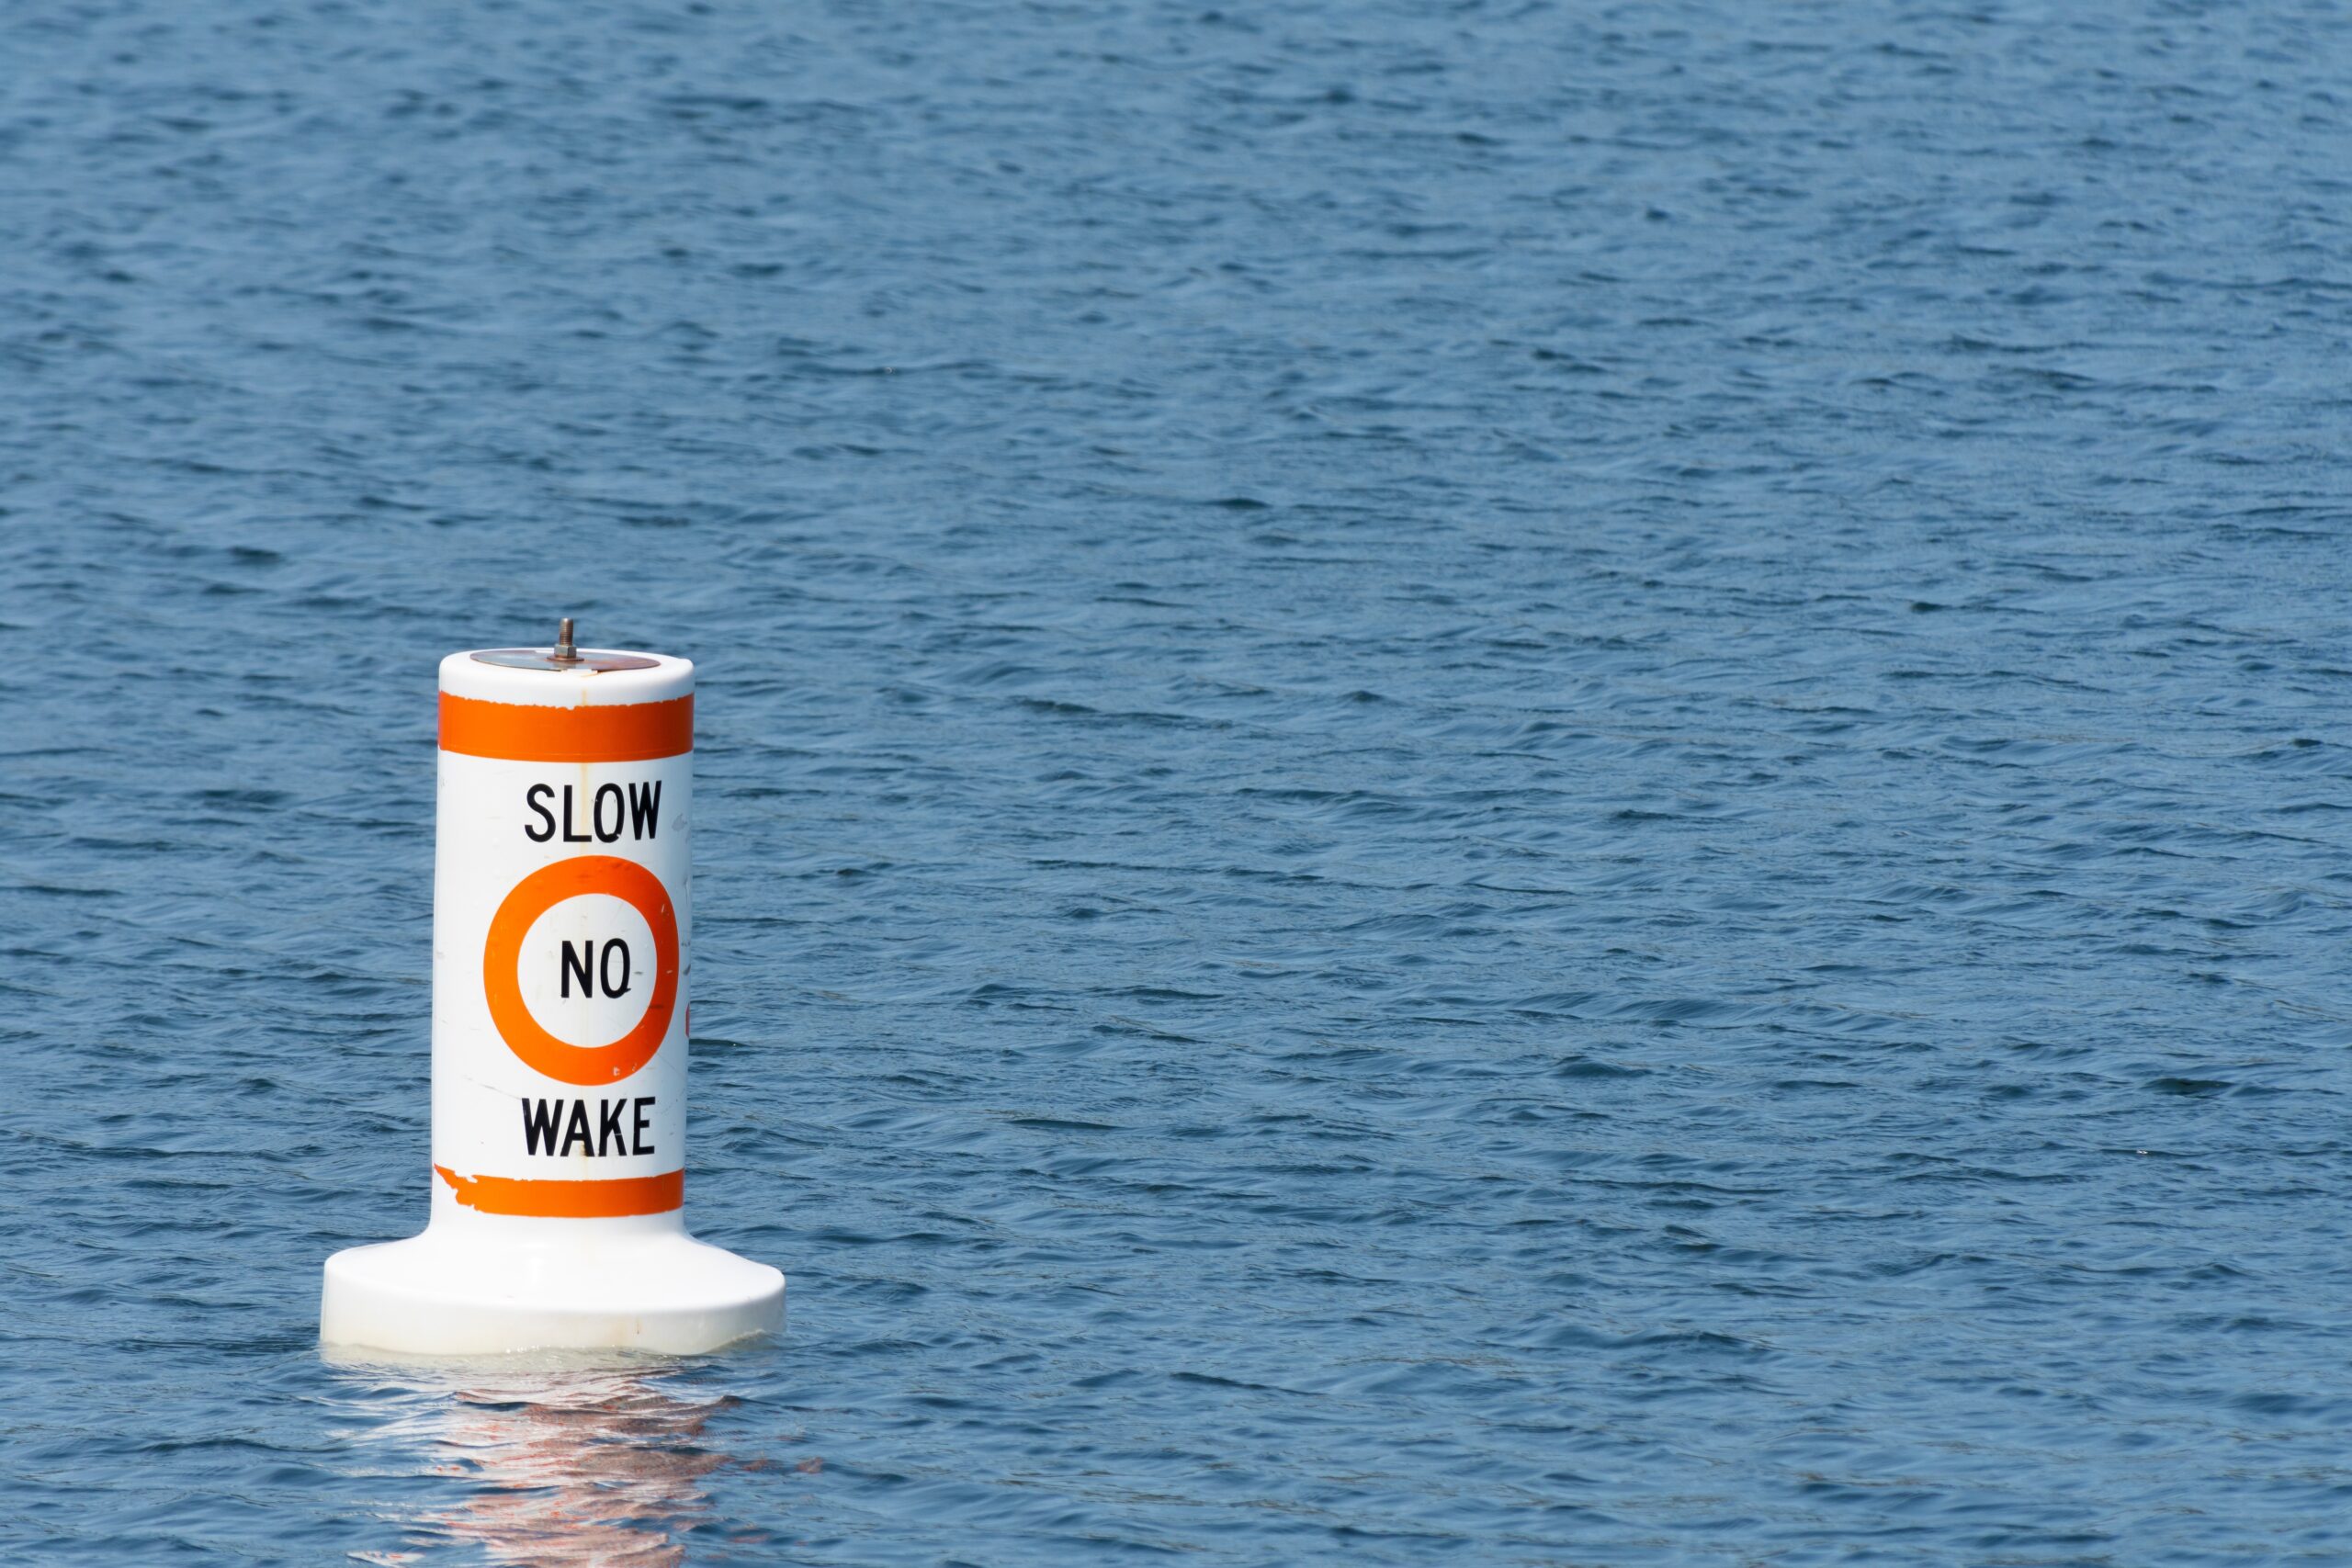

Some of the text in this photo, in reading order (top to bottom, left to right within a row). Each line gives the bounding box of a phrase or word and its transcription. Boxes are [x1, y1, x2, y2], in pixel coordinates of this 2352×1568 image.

[525, 780, 662, 843] SLOW
[560, 938, 631, 999] NO
[521, 1096, 656, 1157] WAKE
